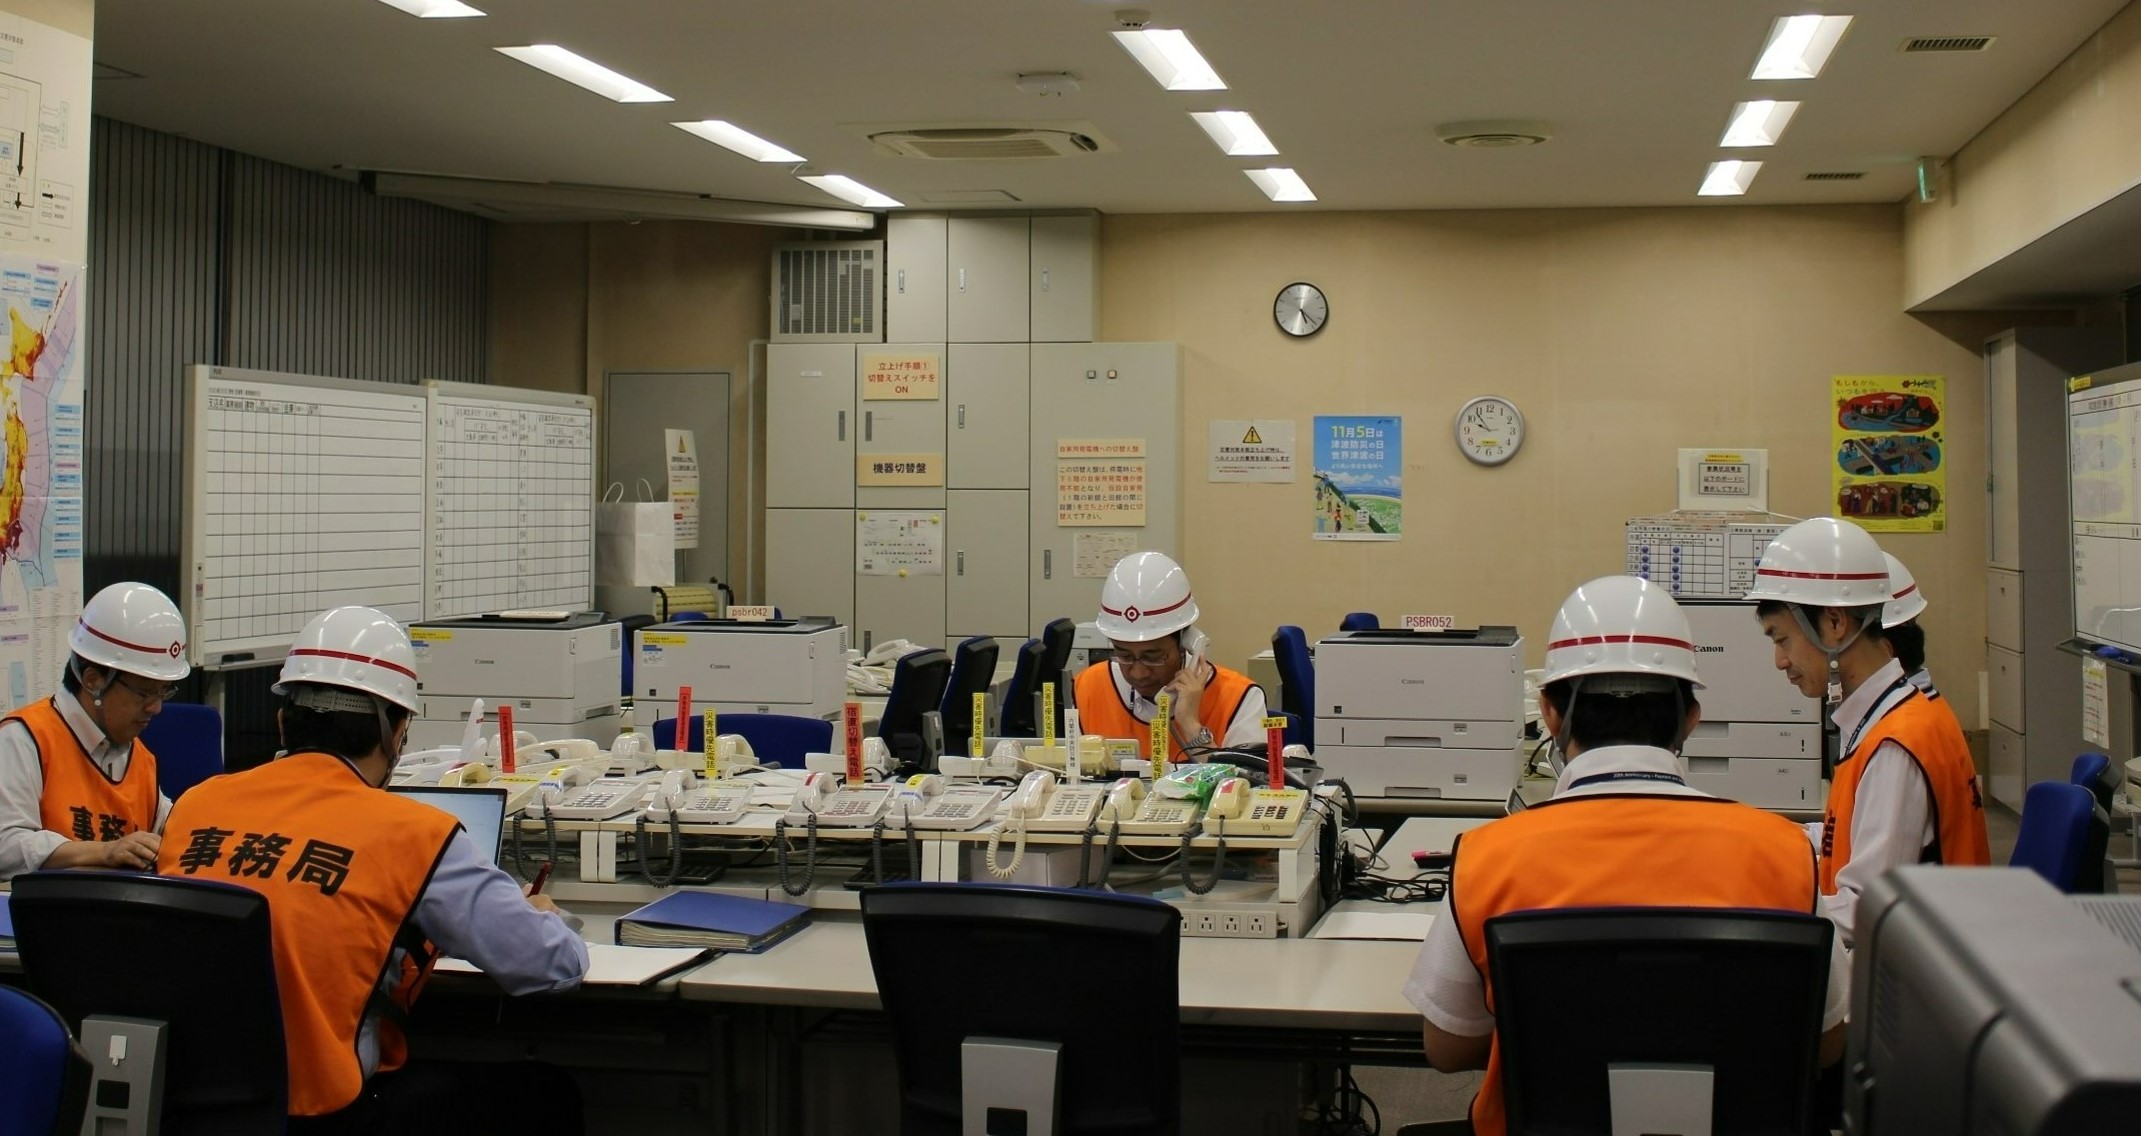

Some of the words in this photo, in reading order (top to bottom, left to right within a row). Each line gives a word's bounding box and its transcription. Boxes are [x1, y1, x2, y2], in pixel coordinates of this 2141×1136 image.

[867, 374, 935, 382] 切替えスイッチを
[895, 385, 909, 394] ON
[1331, 425, 1384, 438] 11月5日は
[1331, 440, 1384, 449] 津波防災の日
[1331, 451, 1384, 460] 世界津波の日
[872, 463, 927, 474] 機器切替盤
[731, 607, 768, 617] psbr042
[1405, 616, 1452, 628] PSBR052
[1693, 645, 1724, 653] Canon
[705, 711, 716, 769] 災害時優先電話
[846, 707, 860, 778] 宿直切替え電話
[69, 805, 140, 843] 事務
[178, 826, 355, 897] 事務局
